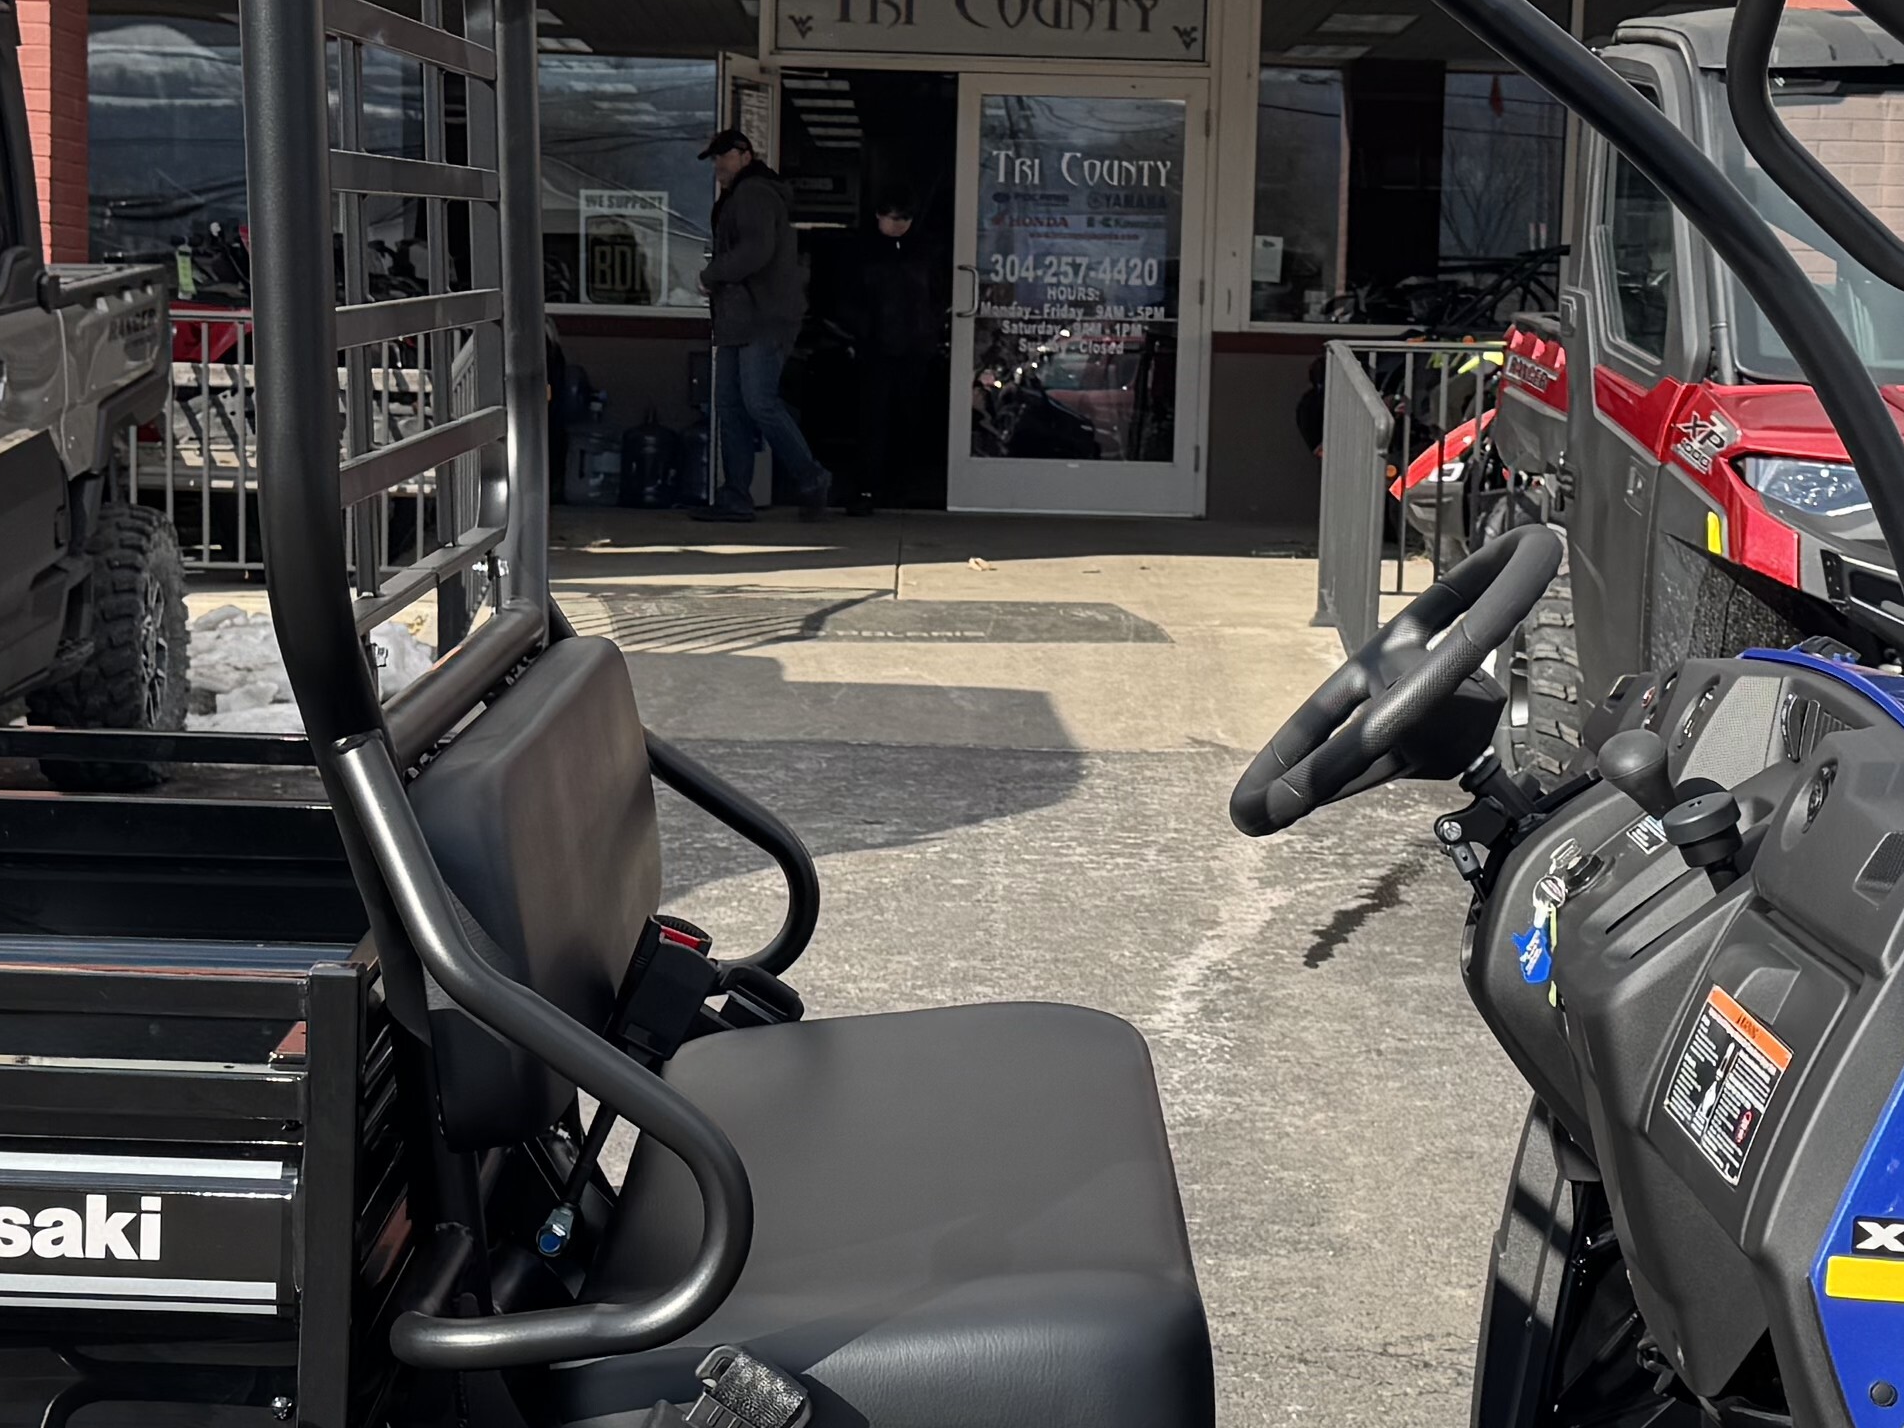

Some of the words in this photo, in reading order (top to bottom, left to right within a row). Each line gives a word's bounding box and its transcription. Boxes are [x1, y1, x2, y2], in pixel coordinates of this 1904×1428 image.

[1007, 215, 1070, 229] HONDA
[989, 253, 1158, 286] 304-257-4420
[1047, 286, 1101, 301] HOURS:
[980, 301, 1031, 320] Monday
[1043, 303, 1084, 321] Friday
[1095, 305, 1125, 320] 9AM
[1137, 306, 1165, 320] 5PM
[1001, 320, 1060, 336] Saturday
[1079, 341, 1124, 355] Closed
[1674, 410, 1727, 451] XP
